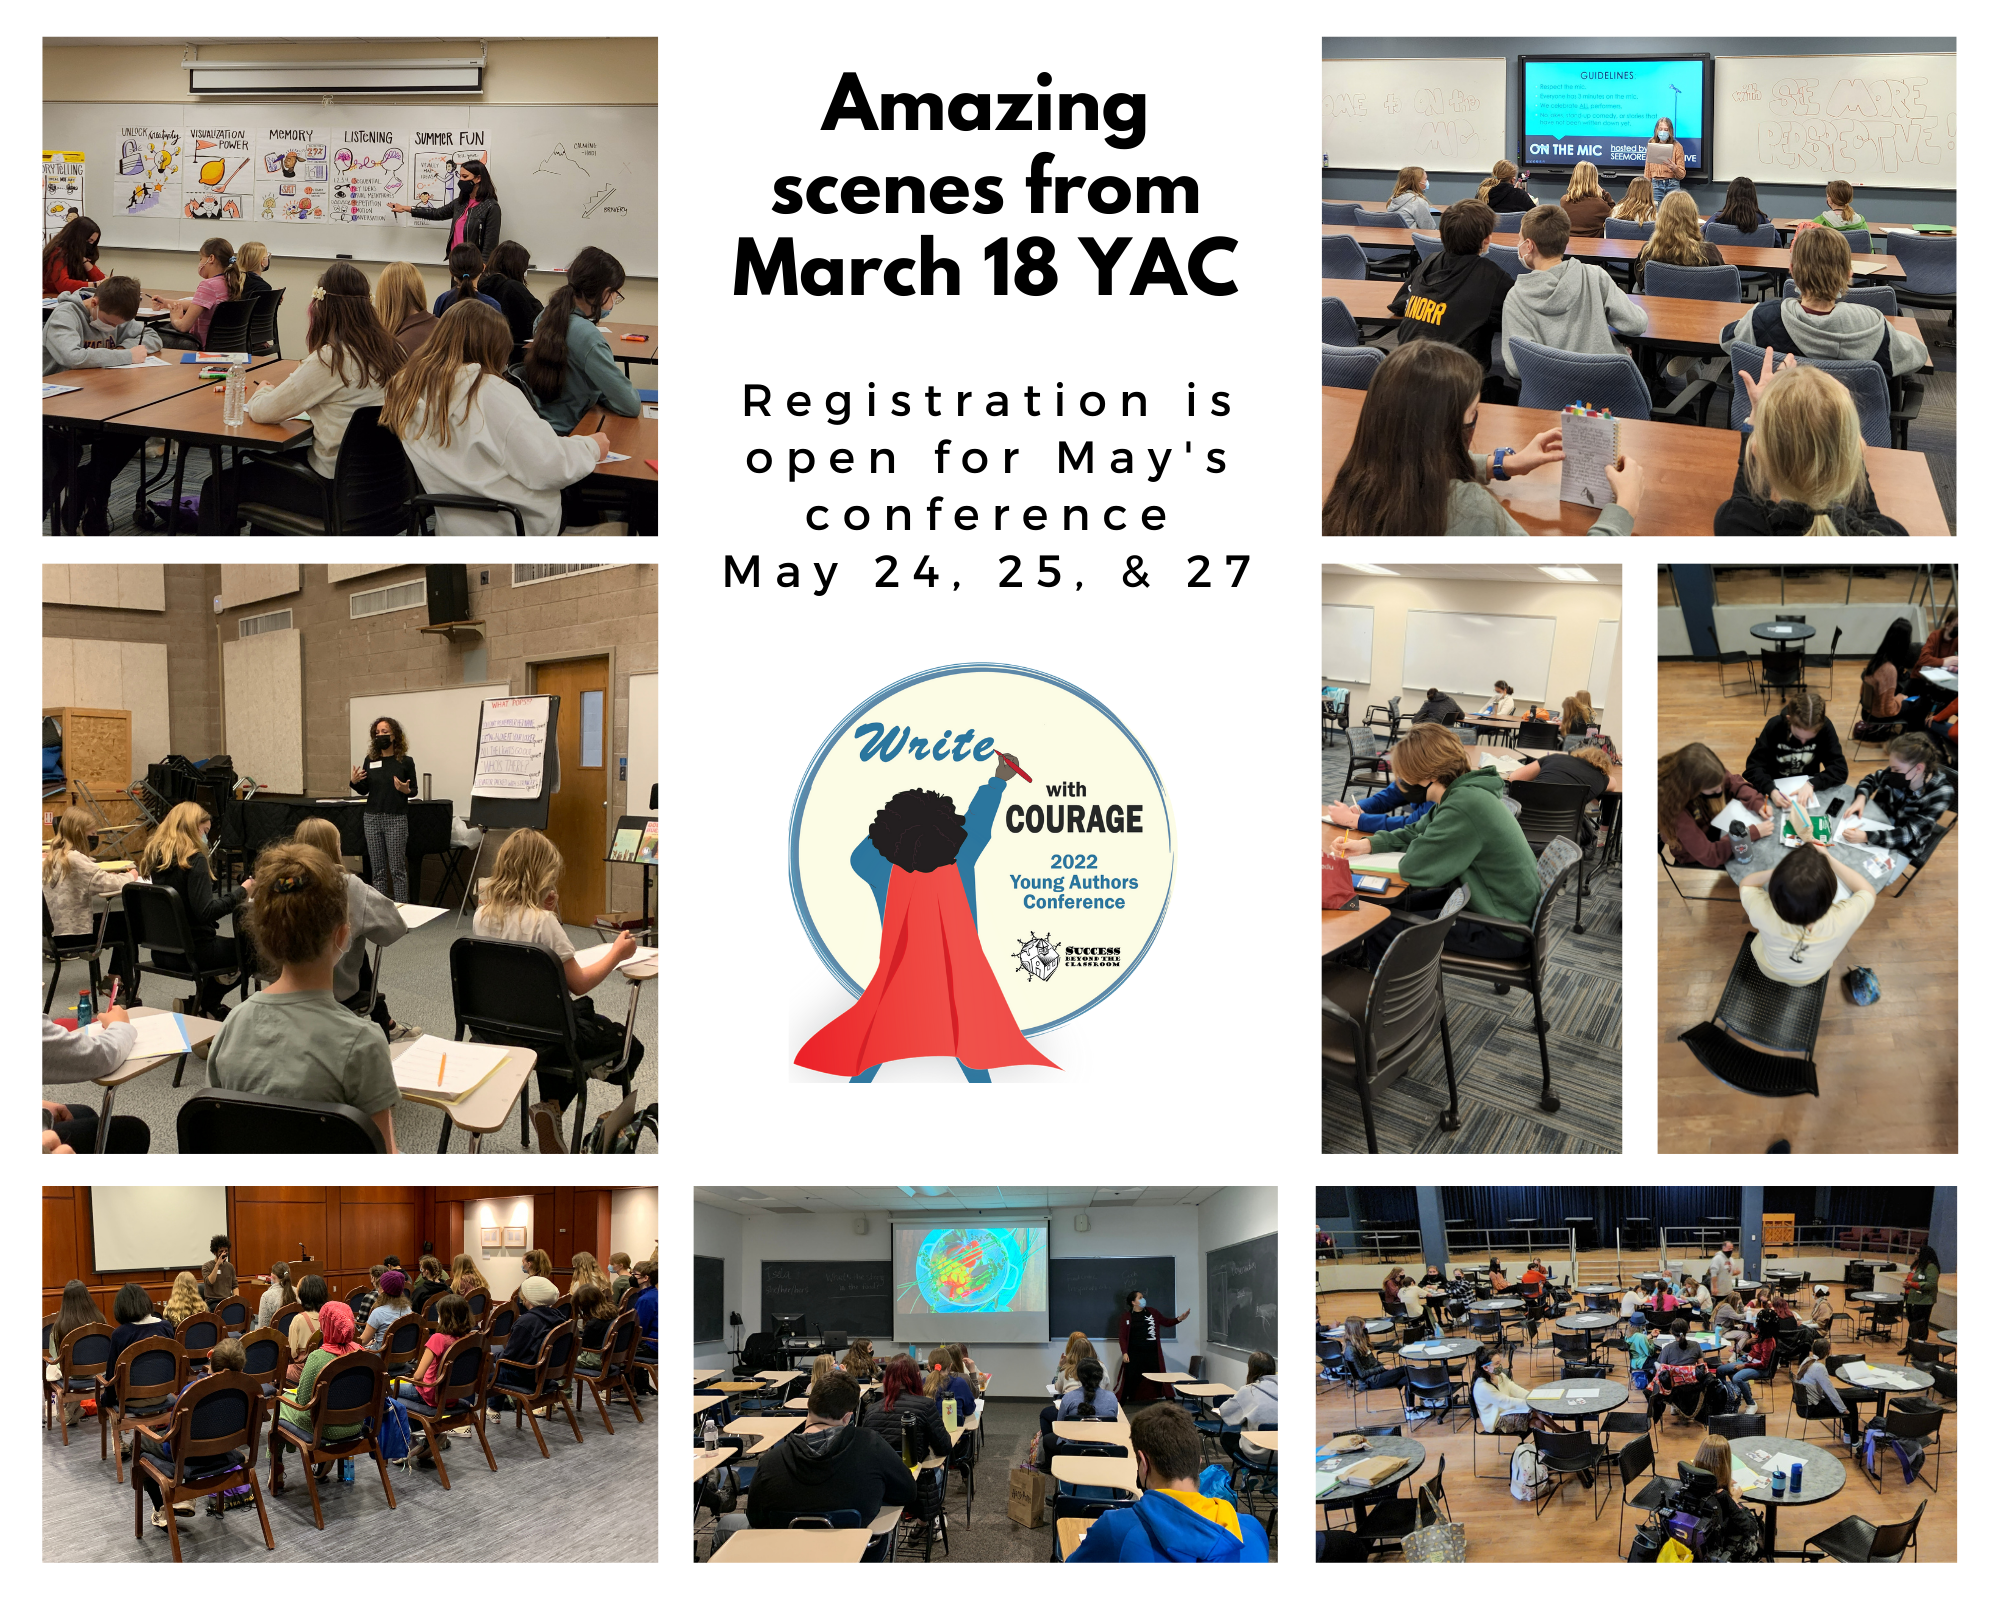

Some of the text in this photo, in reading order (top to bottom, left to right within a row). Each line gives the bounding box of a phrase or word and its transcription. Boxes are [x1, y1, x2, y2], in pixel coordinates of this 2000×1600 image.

[1414, 88, 1444, 116] ON
[1826, 77, 1928, 119] MORE
[122, 127, 148, 137] UNLOCK
[190, 130, 245, 139] VISUALIZATION
[460, 130, 484, 146] FUN
[1414, 118, 1480, 159] MIC
[218, 140, 249, 150] POWER
[1530, 144, 1603, 156] ON THE MIC
[1610, 144, 1637, 152] hosted
[1610, 152, 1646, 160] SEEMORE
[492, 700, 508, 708] WHAT
